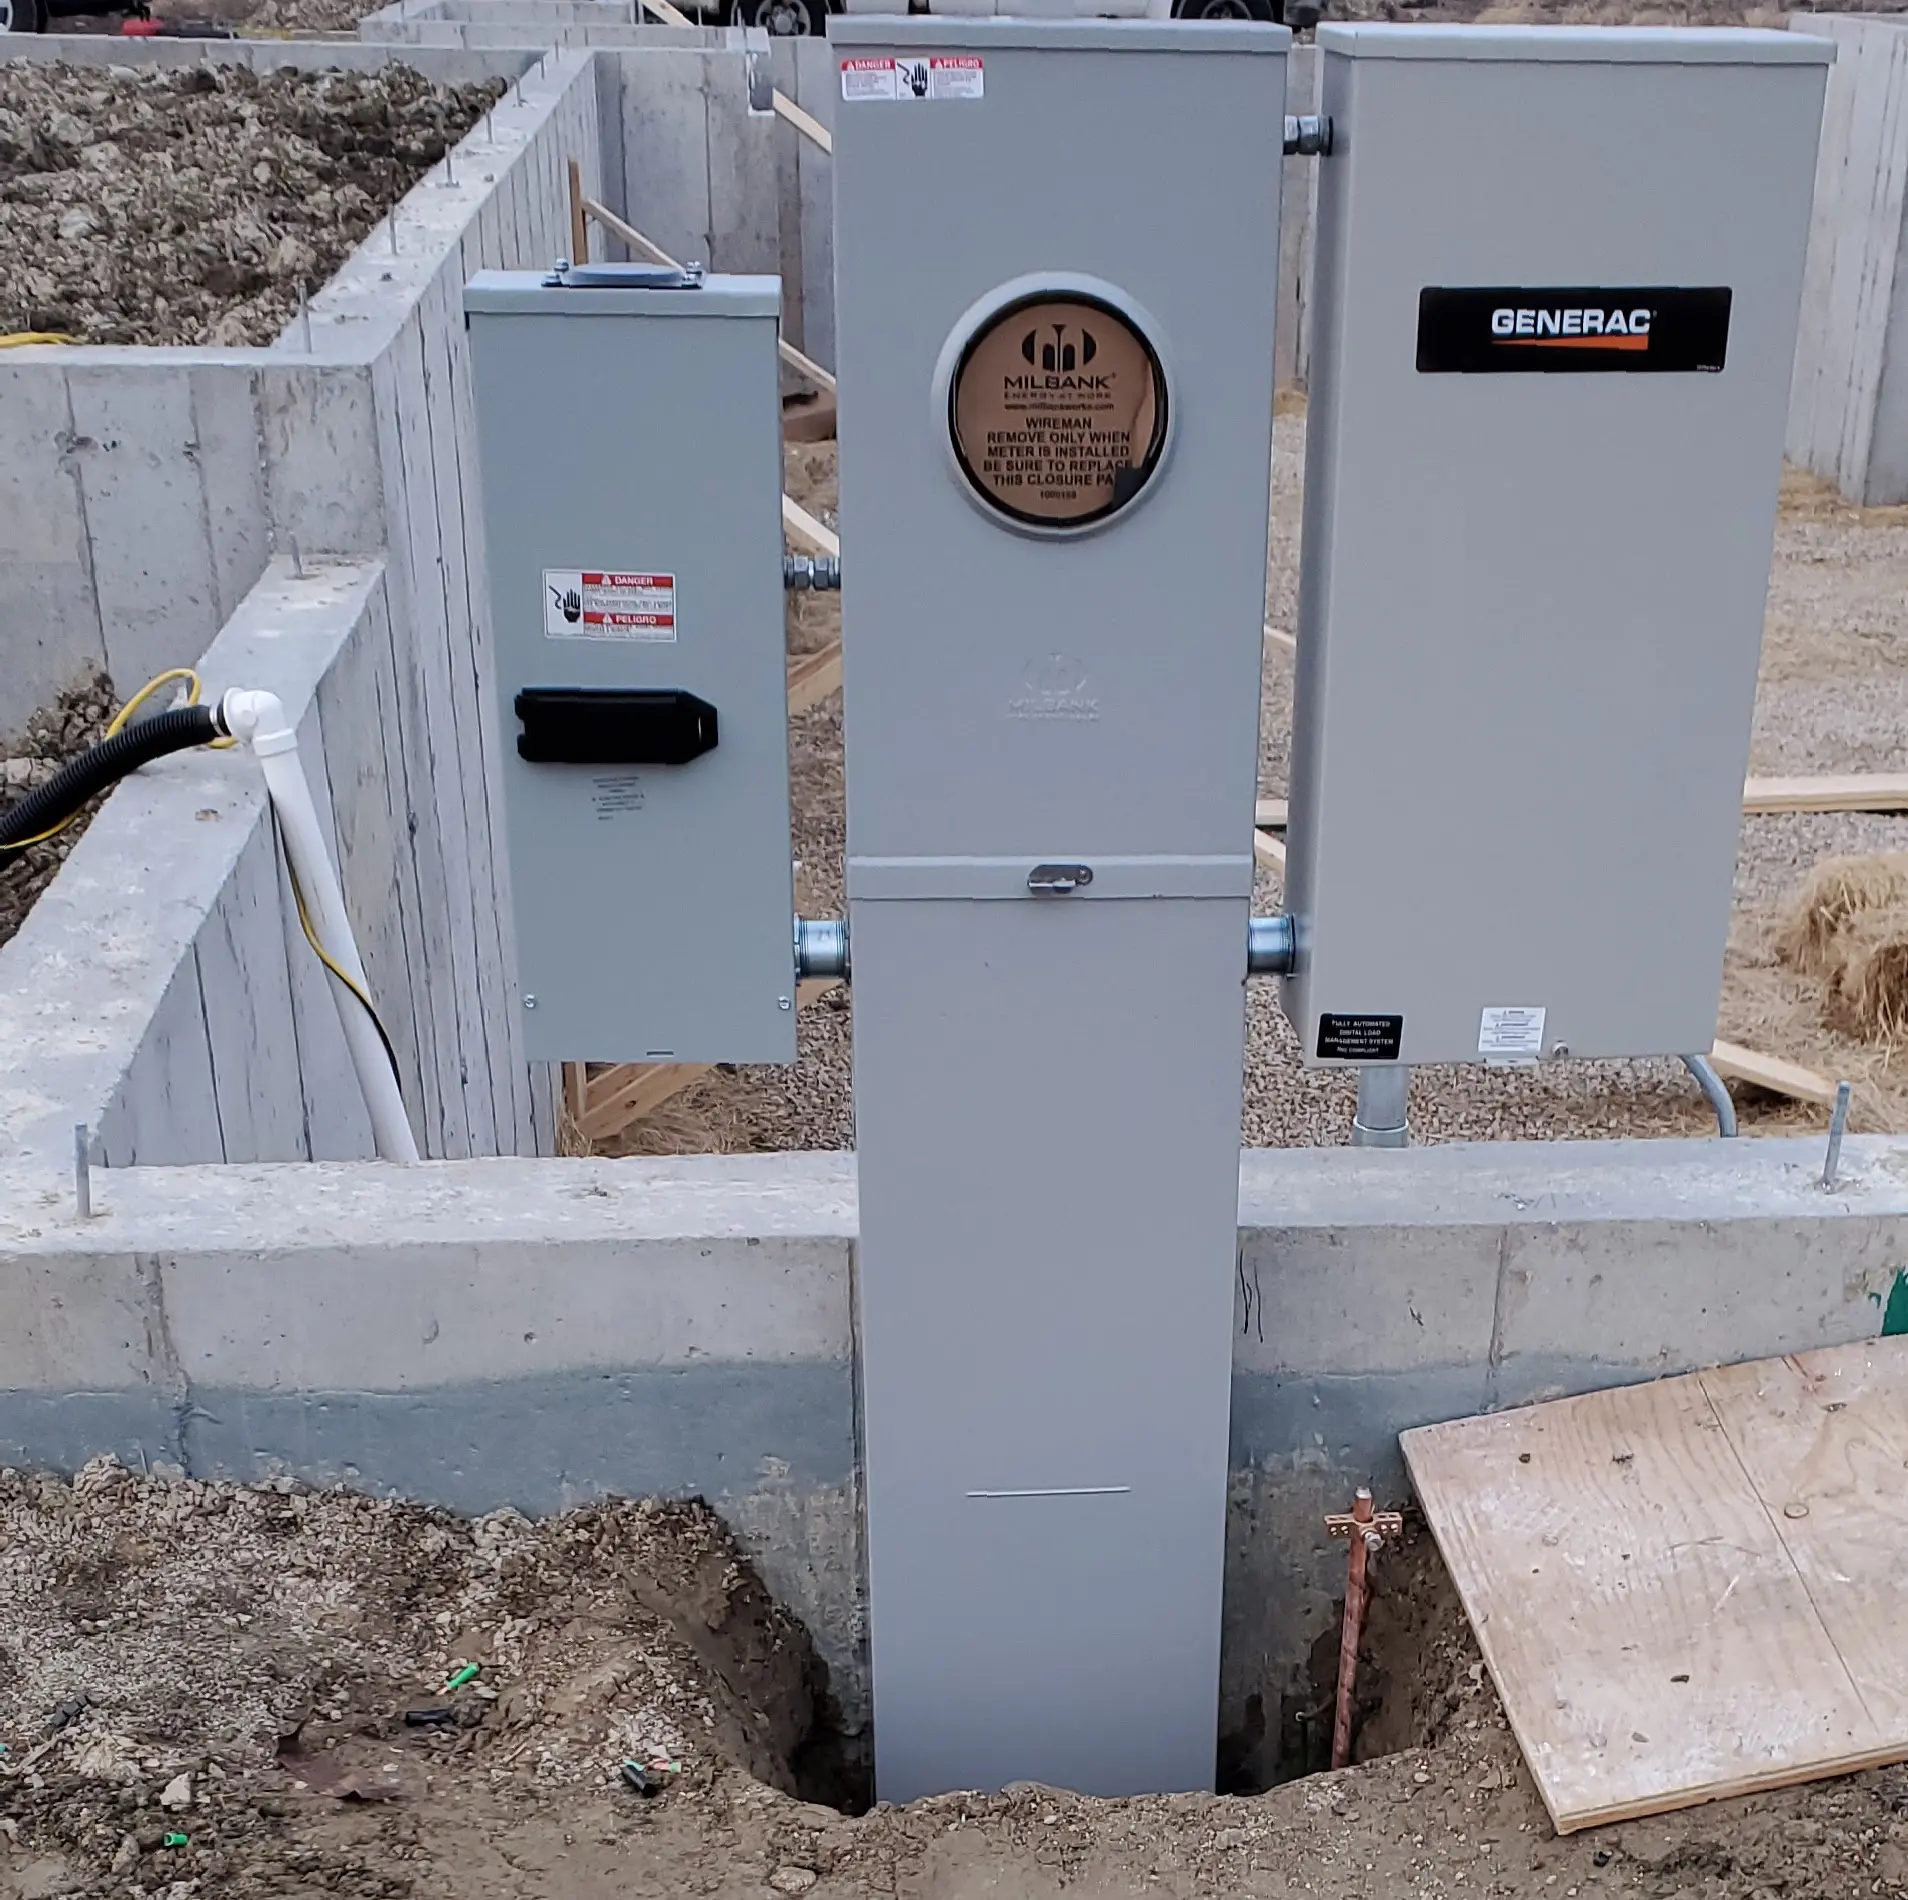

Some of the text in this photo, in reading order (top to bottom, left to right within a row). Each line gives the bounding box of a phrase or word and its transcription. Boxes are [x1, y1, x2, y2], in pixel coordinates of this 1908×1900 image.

[1491, 309, 1650, 335] GENERAC
[1004, 375, 1110, 390] MILBANK
[1026, 417, 1092, 430] WIREMAN
[987, 431, 1131, 444] REMOVE ONLY WHEN
[987, 446, 1130, 458] METER IS INSTALLED
[983, 460, 1002, 472] BE
[1006, 460, 1043, 472] SURE
[1048, 460, 1065, 472] TO
[993, 474, 1023, 486] THIS
[1027, 474, 1093, 486] CLOSURE
[614, 576, 654, 585] DANGER
[615, 615, 657, 624] PELIGRO
